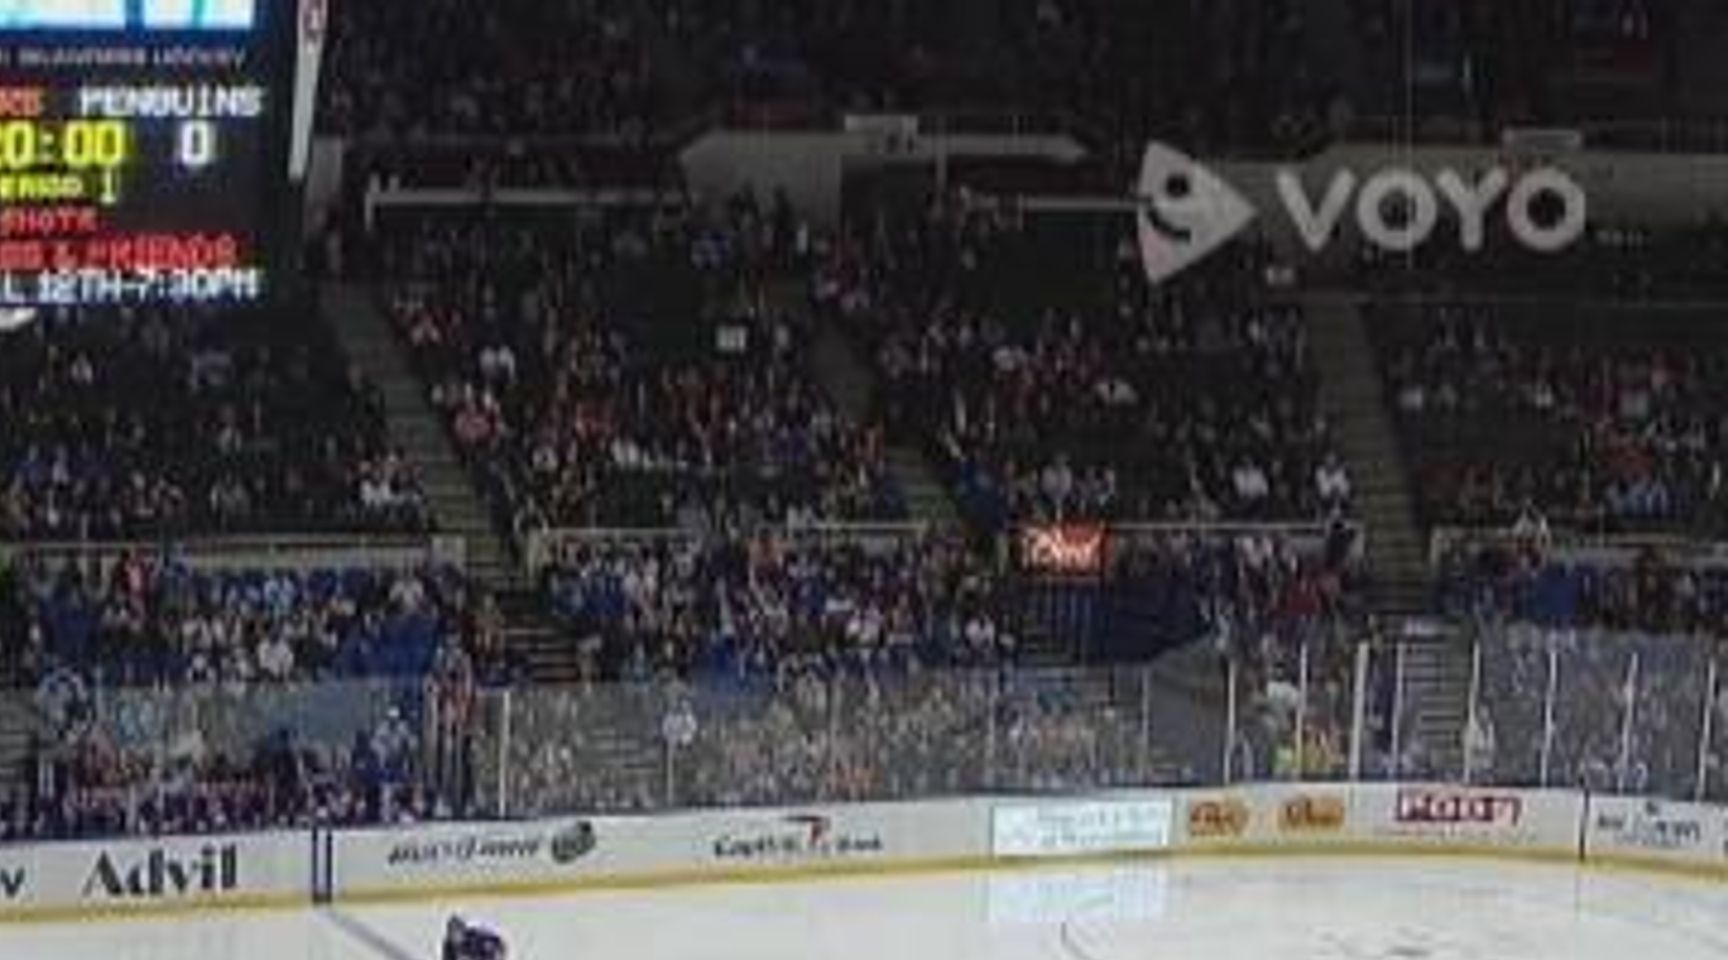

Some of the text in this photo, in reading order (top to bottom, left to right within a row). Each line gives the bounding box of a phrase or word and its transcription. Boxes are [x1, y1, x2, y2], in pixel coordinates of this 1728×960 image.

[78, 86, 262, 117] PENGUINS
[180, 118, 210, 167] 0
[82, 842, 238, 897] Advil
